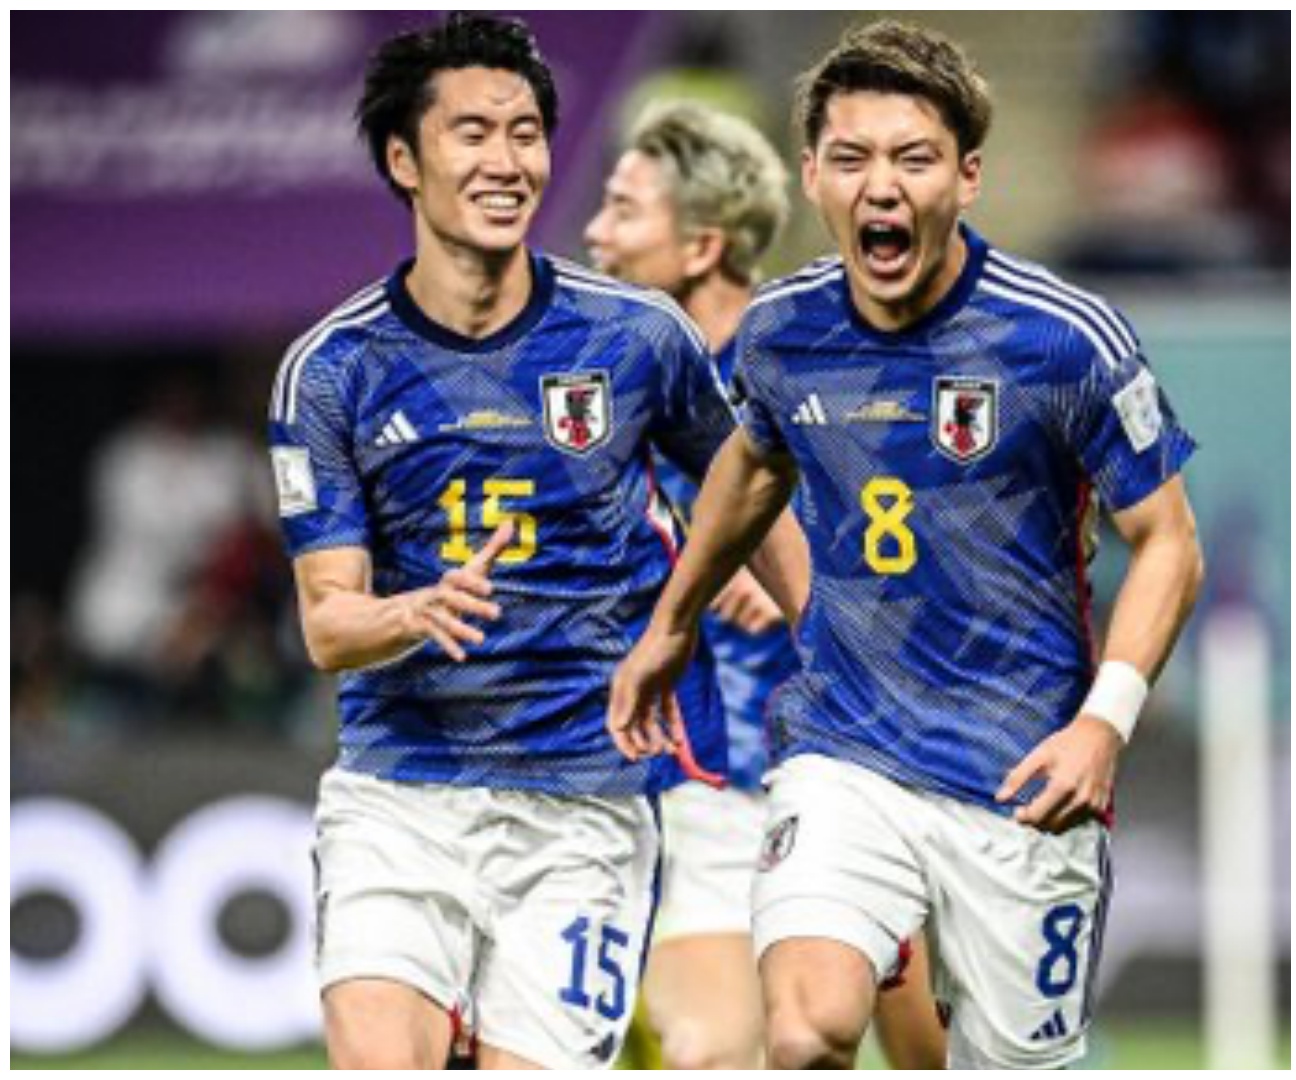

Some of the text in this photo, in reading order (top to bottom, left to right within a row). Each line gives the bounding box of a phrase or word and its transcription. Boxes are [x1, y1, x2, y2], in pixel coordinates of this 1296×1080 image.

[438, 479, 536, 563] 15
[861, 475, 918, 575] 8
[559, 916, 629, 1020] 15
[1036, 904, 1084, 998] 8
